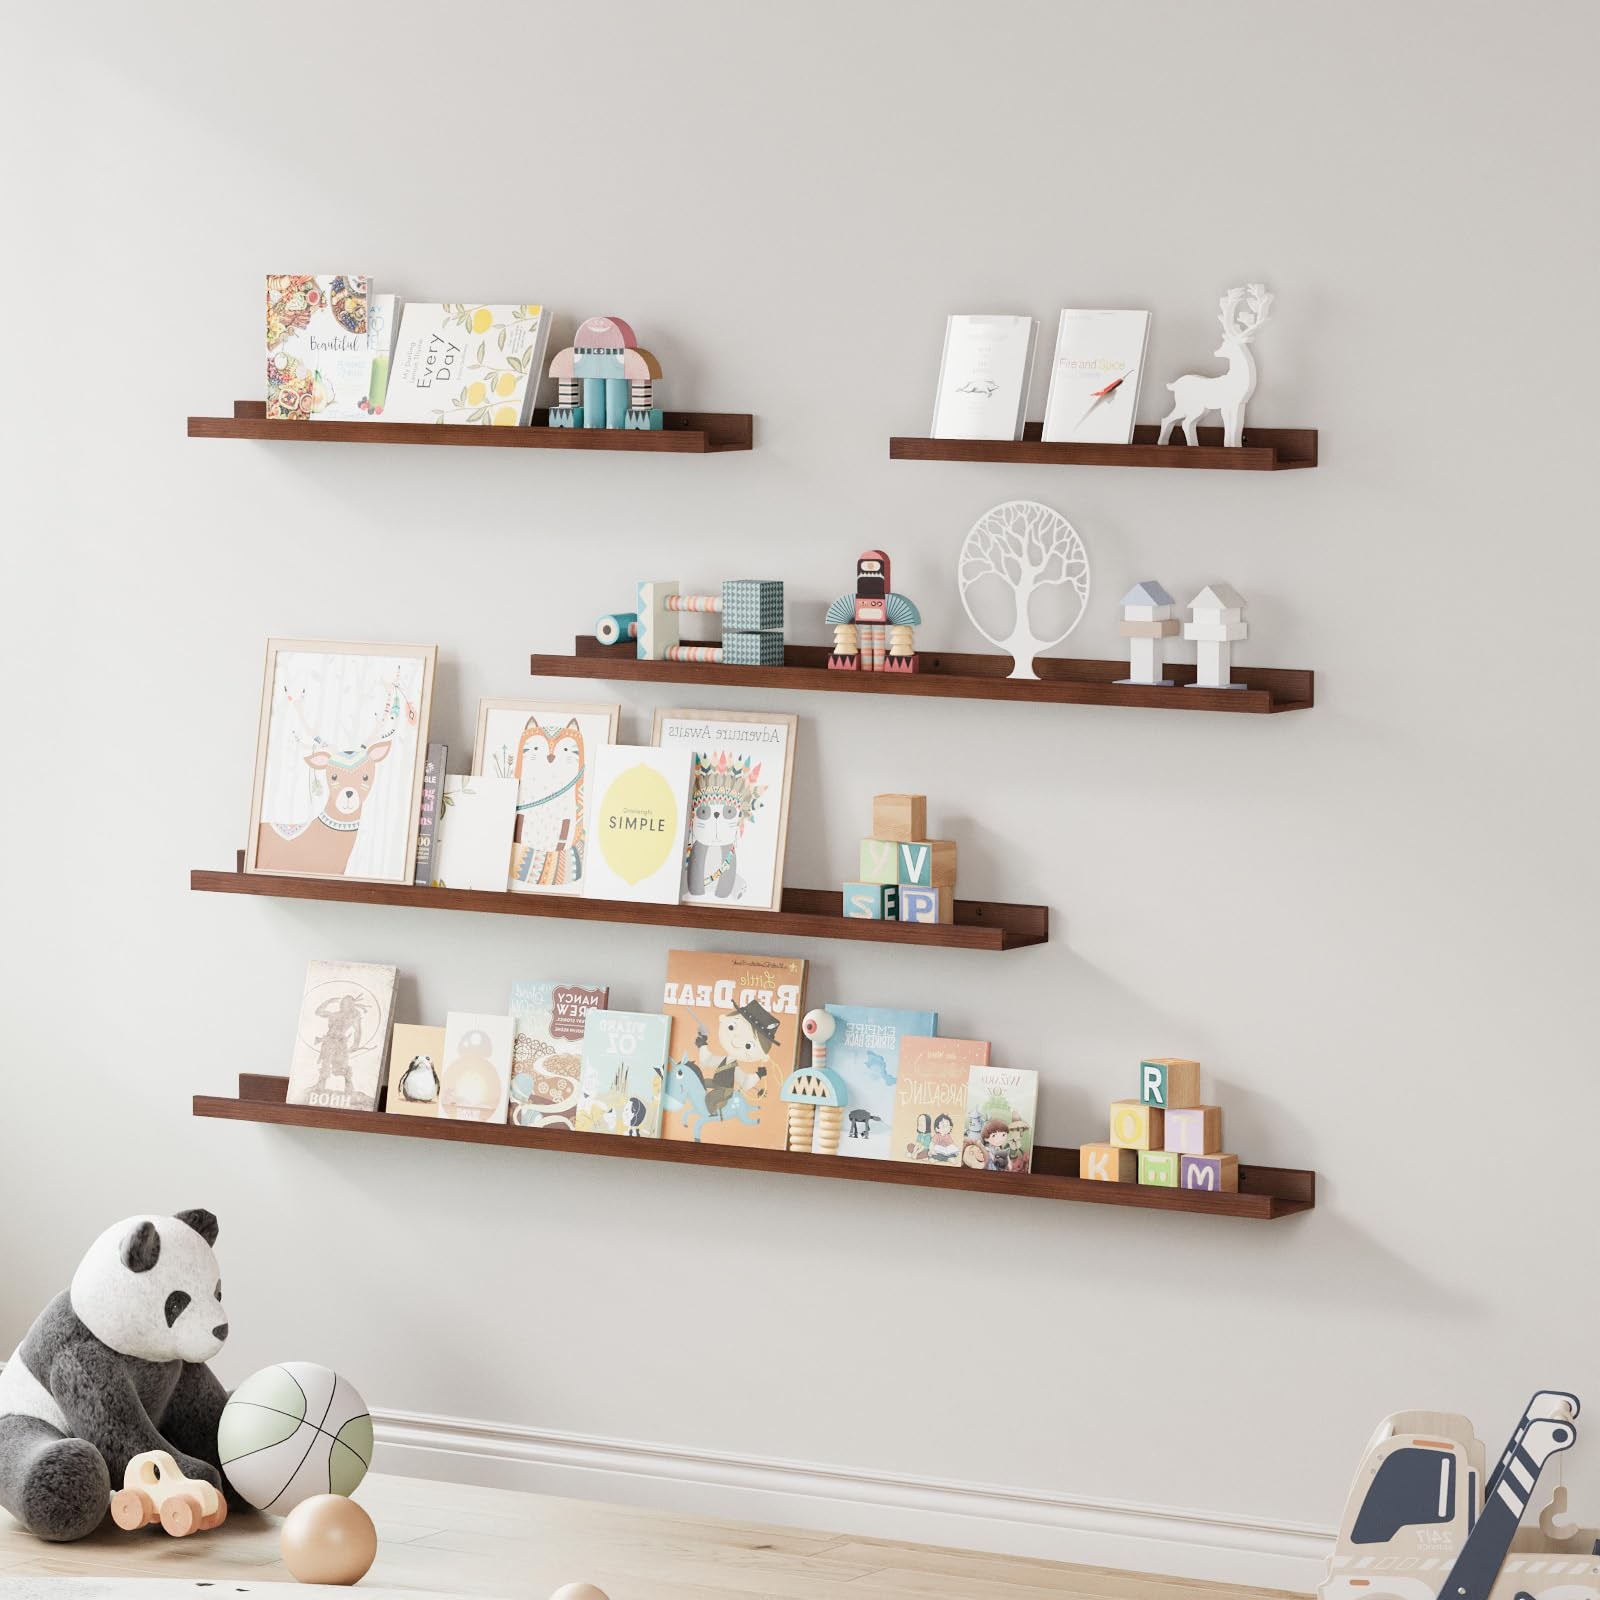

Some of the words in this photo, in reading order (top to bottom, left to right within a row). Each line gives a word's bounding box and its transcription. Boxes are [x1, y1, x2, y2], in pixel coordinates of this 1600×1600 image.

[310, 336, 360, 351] Beautiful
[416, 334, 445, 388] Every
[436, 342, 461, 381] Day
[609, 816, 665, 832] SIMPLE
[901, 844, 928, 883] V
[905, 894, 933, 921] P
[1144, 1066, 1164, 1103] R
[1115, 1108, 1143, 1144] O
[1088, 1151, 1110, 1182] K
[1187, 1163, 1214, 1191] M
